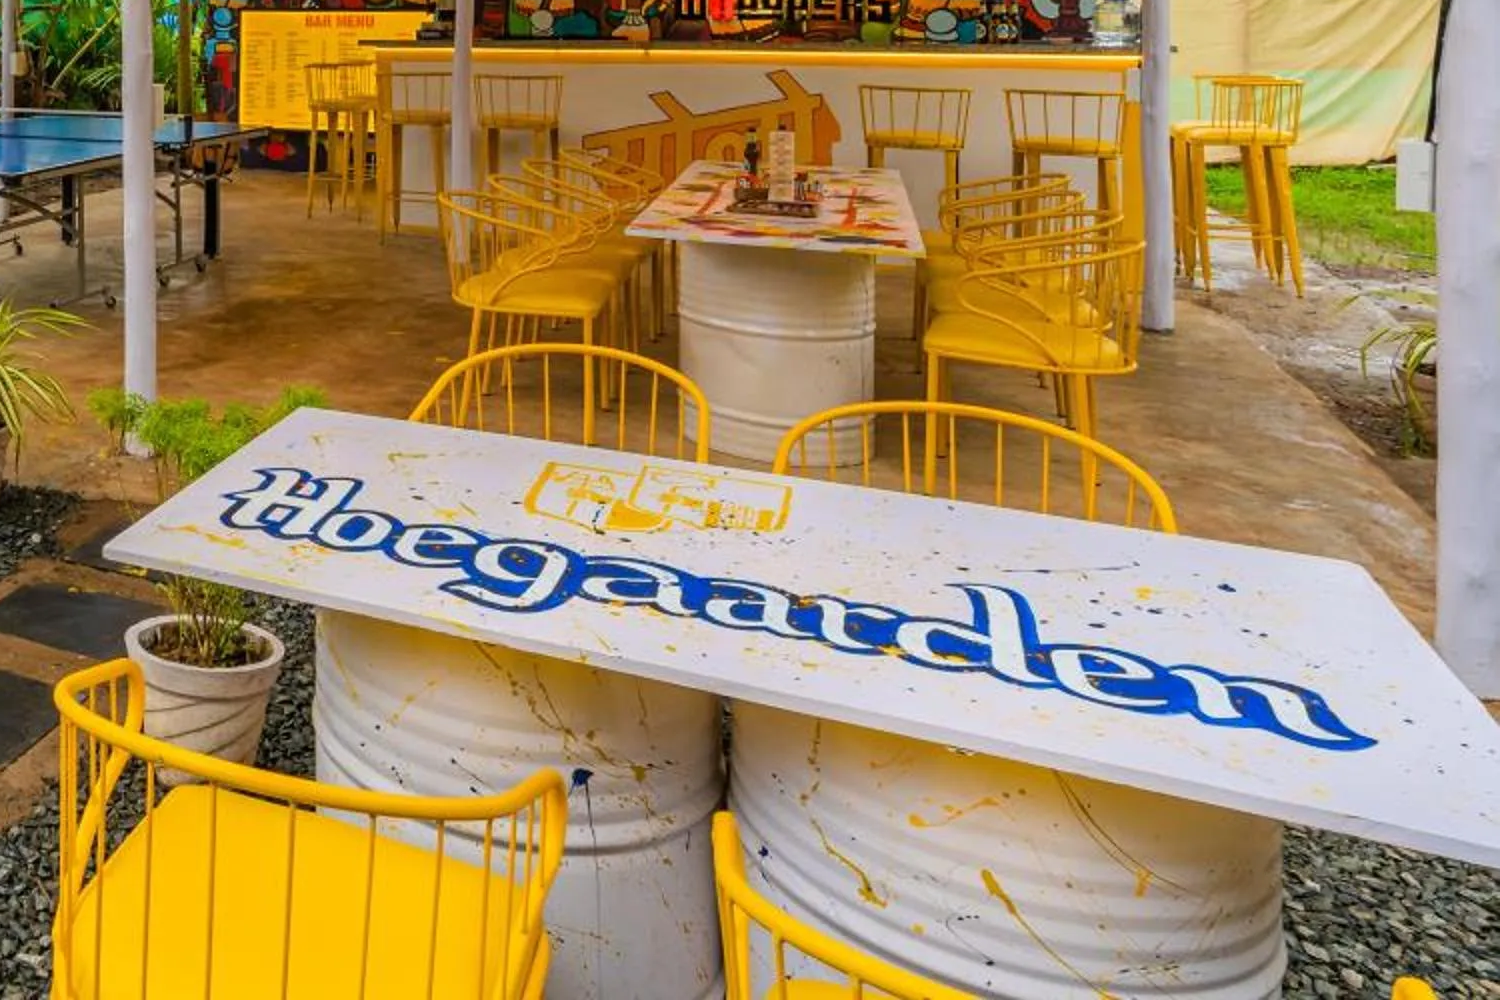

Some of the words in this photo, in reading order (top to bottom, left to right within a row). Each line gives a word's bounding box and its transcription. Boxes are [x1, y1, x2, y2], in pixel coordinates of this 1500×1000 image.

[305, 14, 332, 28] BAR
[336, 14, 375, 28] MENU
[221, 466, 1378, 751] Hoegaarden
